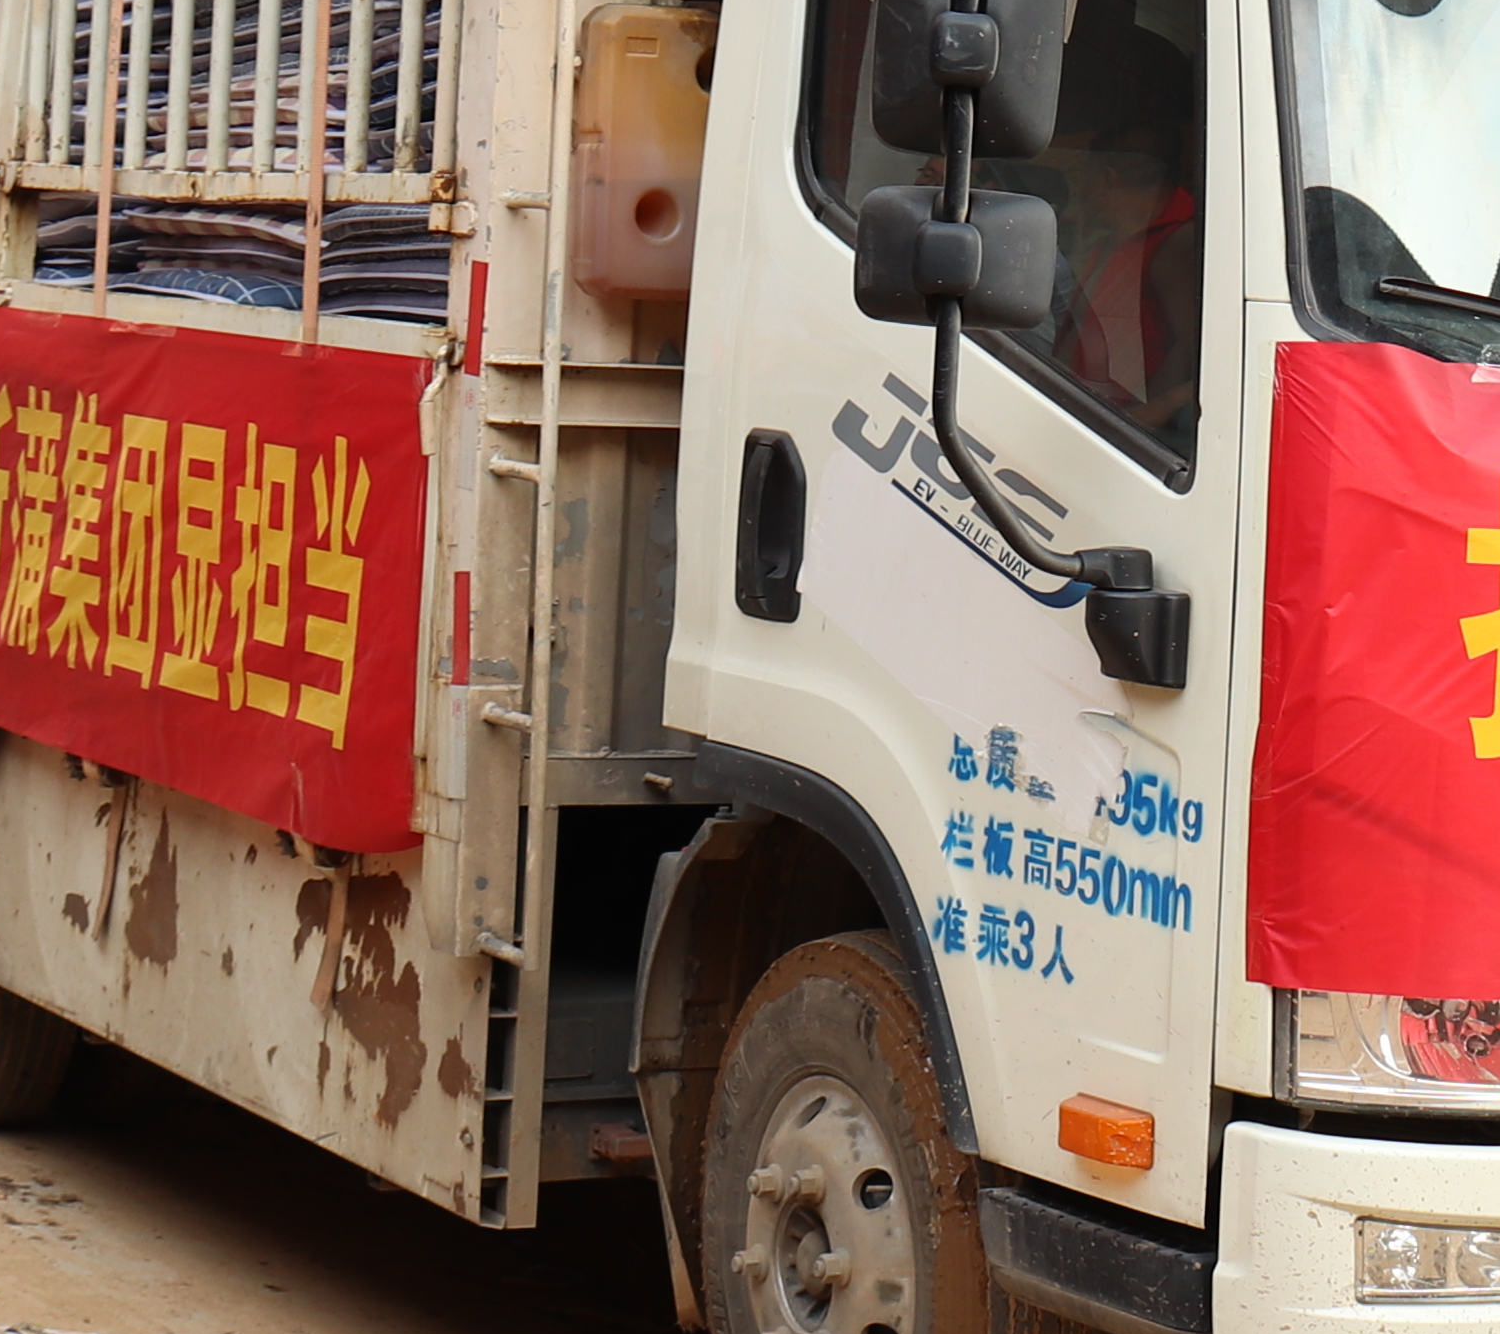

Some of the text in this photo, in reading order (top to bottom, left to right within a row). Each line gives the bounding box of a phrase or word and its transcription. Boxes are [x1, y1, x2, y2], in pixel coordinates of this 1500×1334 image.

[912, 477, 938, 504] EV
[953, 513, 999, 556] BLUE
[998, 545, 1034, 581] WAY
[940, 811, 1193, 932] 栏板高550mm
[933, 896, 1075, 985] 准乘3人
